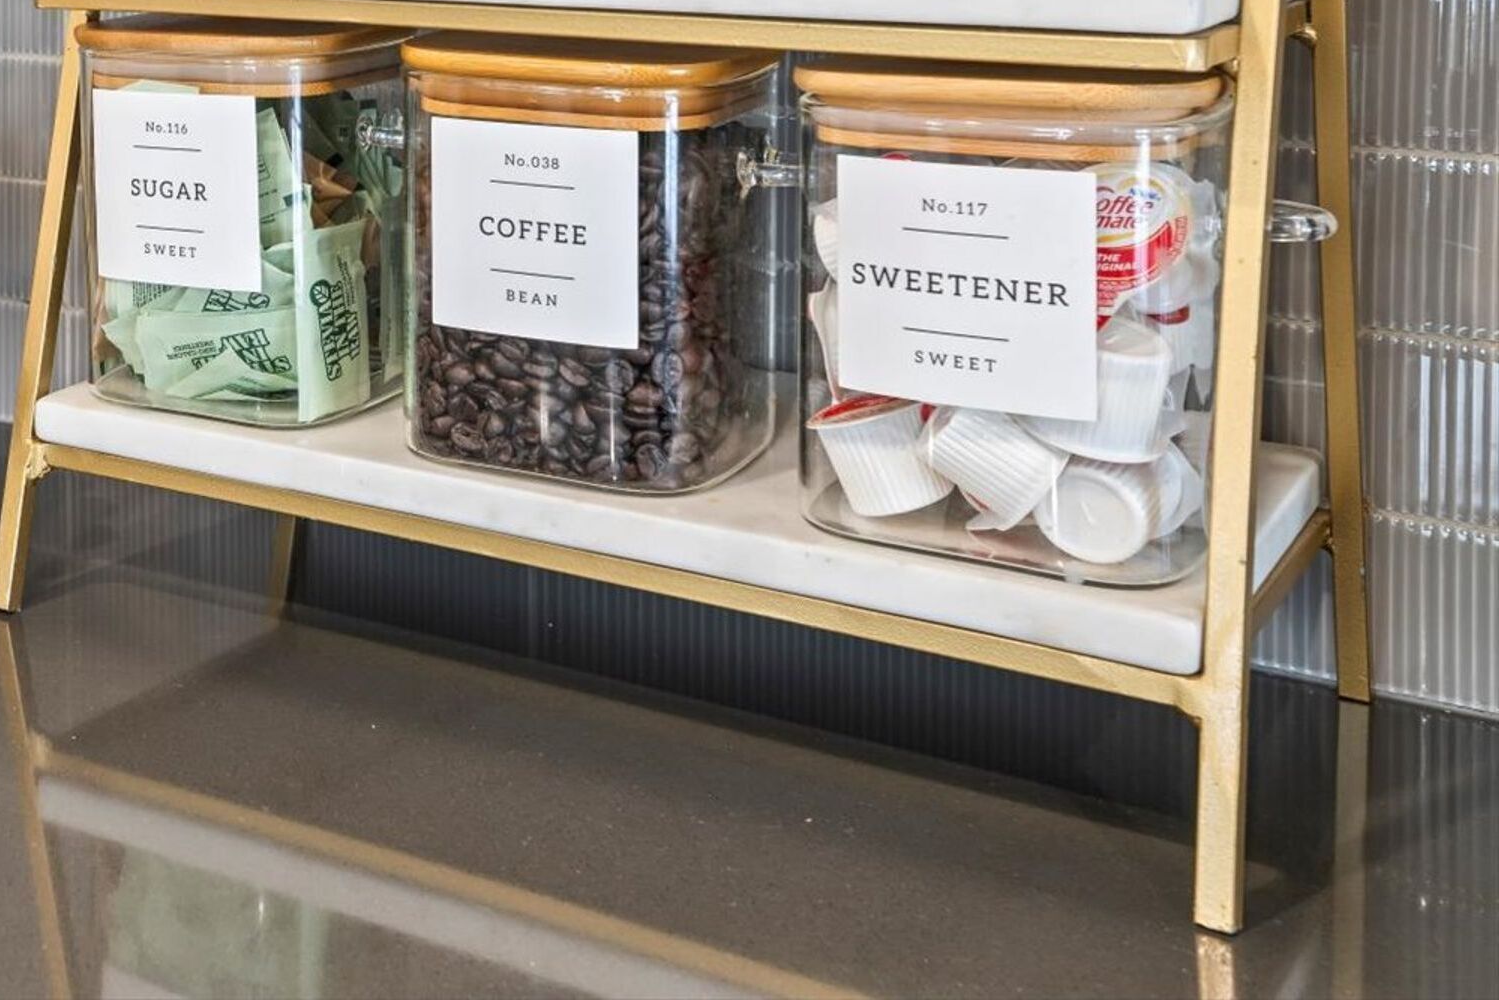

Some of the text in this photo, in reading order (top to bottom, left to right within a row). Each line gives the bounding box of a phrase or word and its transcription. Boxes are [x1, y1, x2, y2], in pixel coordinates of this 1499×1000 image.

[145, 120, 189, 136] No.116
[504, 153, 562, 171] No.038
[130, 177, 209, 203] SUGAR
[921, 197, 989, 217] No.117
[478, 215, 588, 247] COFFEE
[143, 242, 198, 259] SWEET
[851, 262, 1071, 308] SWEETENER
[505, 288, 559, 308] BEAN
[913, 348, 998, 374] SWEET
